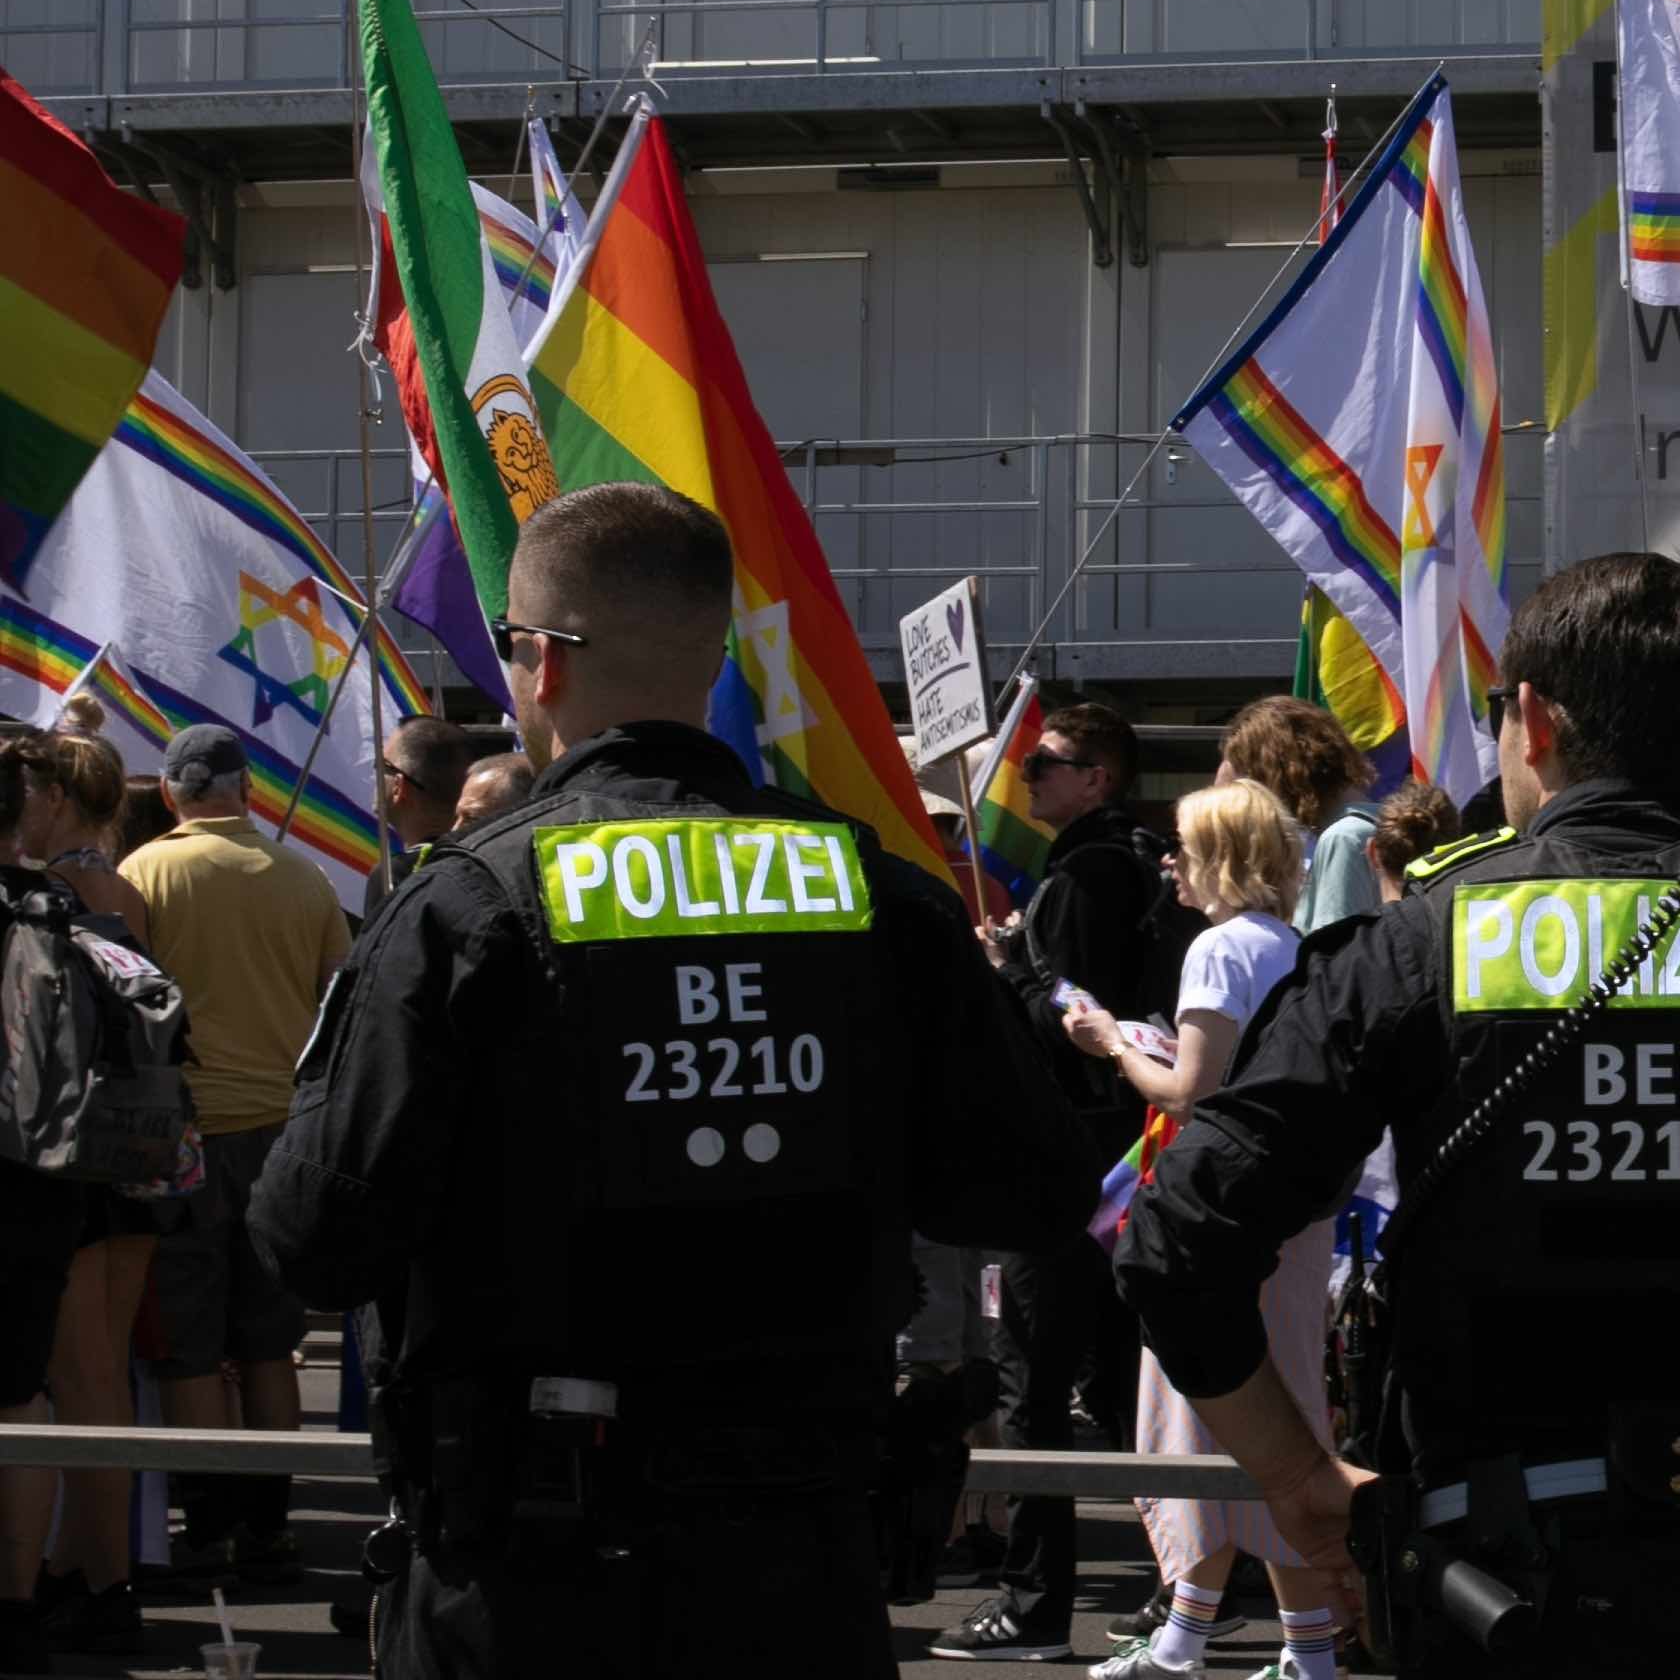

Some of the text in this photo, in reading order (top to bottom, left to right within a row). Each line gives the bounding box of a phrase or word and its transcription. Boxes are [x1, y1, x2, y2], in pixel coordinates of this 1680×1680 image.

[906, 614, 931, 658] LOVE
[910, 636, 950, 685] BUTCHES
[917, 687, 943, 725] HATE
[556, 831, 855, 923] POLIZEI
[675, 962, 768, 1025] BE
[622, 1033, 824, 1102] 23210
[1584, 1043, 1677, 1105] BE
